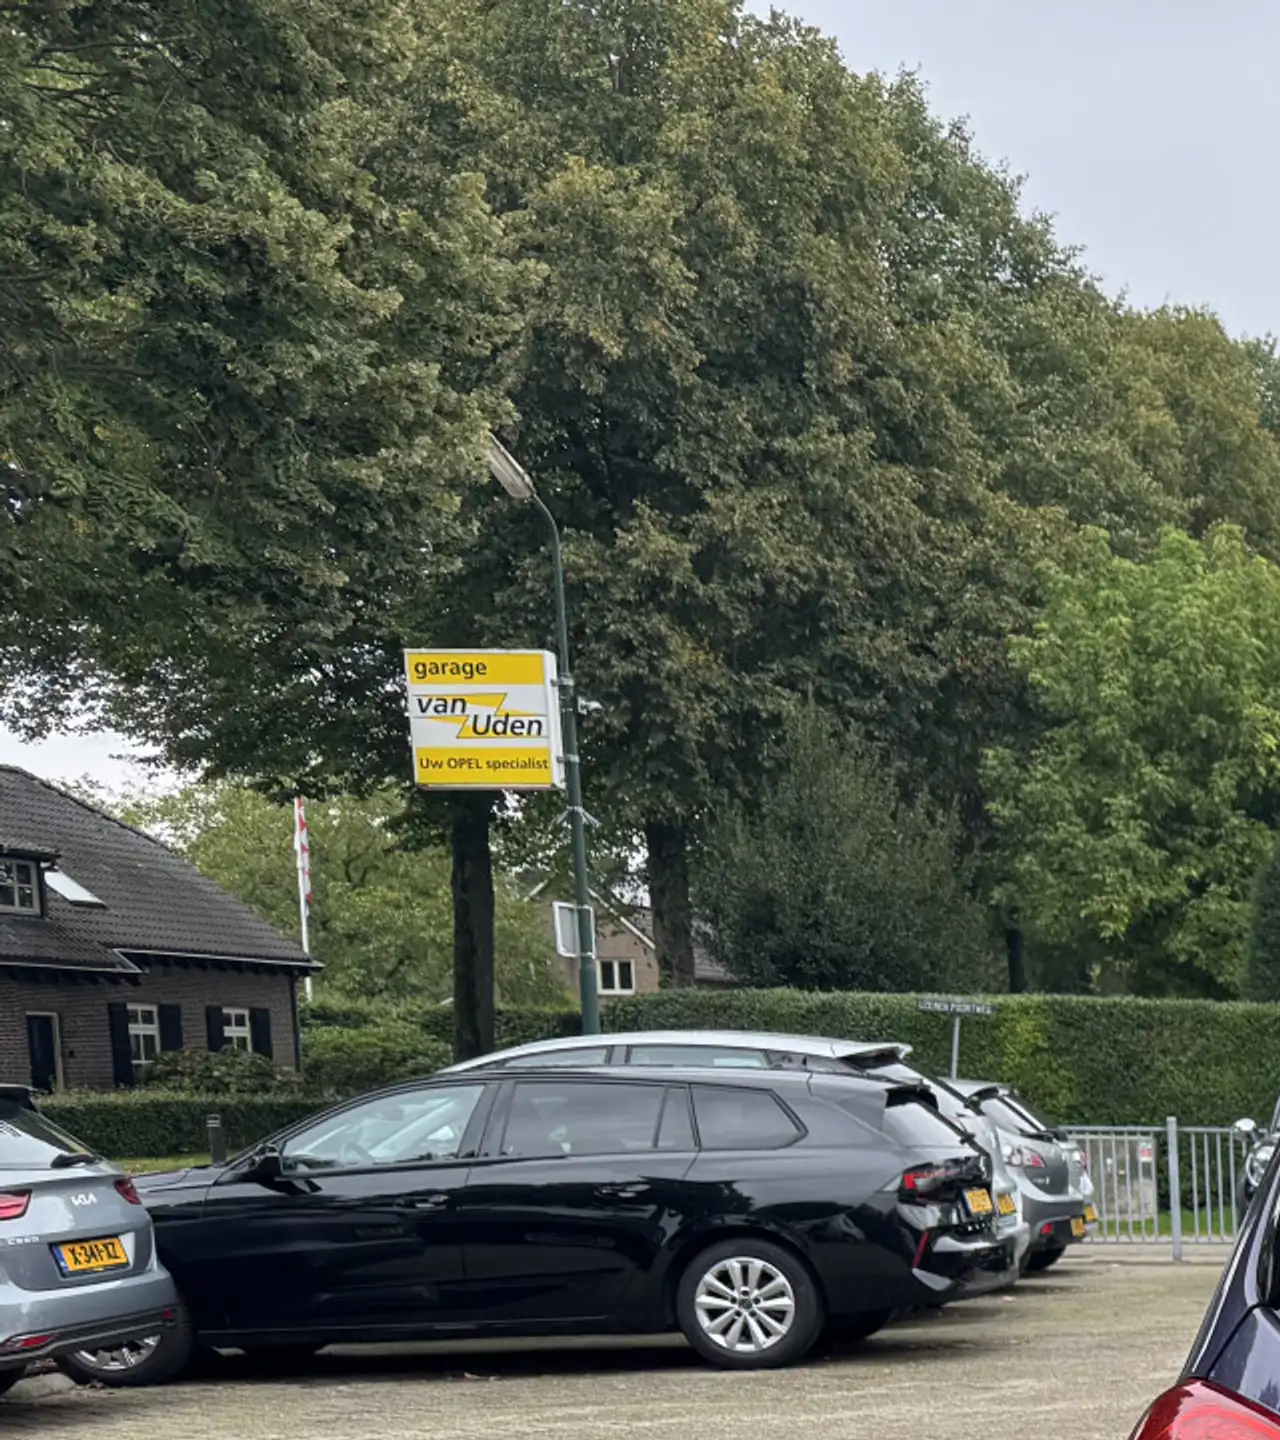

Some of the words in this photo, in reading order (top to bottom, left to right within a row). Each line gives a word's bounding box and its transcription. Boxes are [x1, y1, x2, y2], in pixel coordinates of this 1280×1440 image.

[414, 661, 487, 679] garage
[417, 697, 466, 714] van
[472, 713, 543, 736] Uden
[420, 758, 442, 769] Uw
[447, 758, 483, 770] OPEL
[486, 757, 549, 771] specialist
